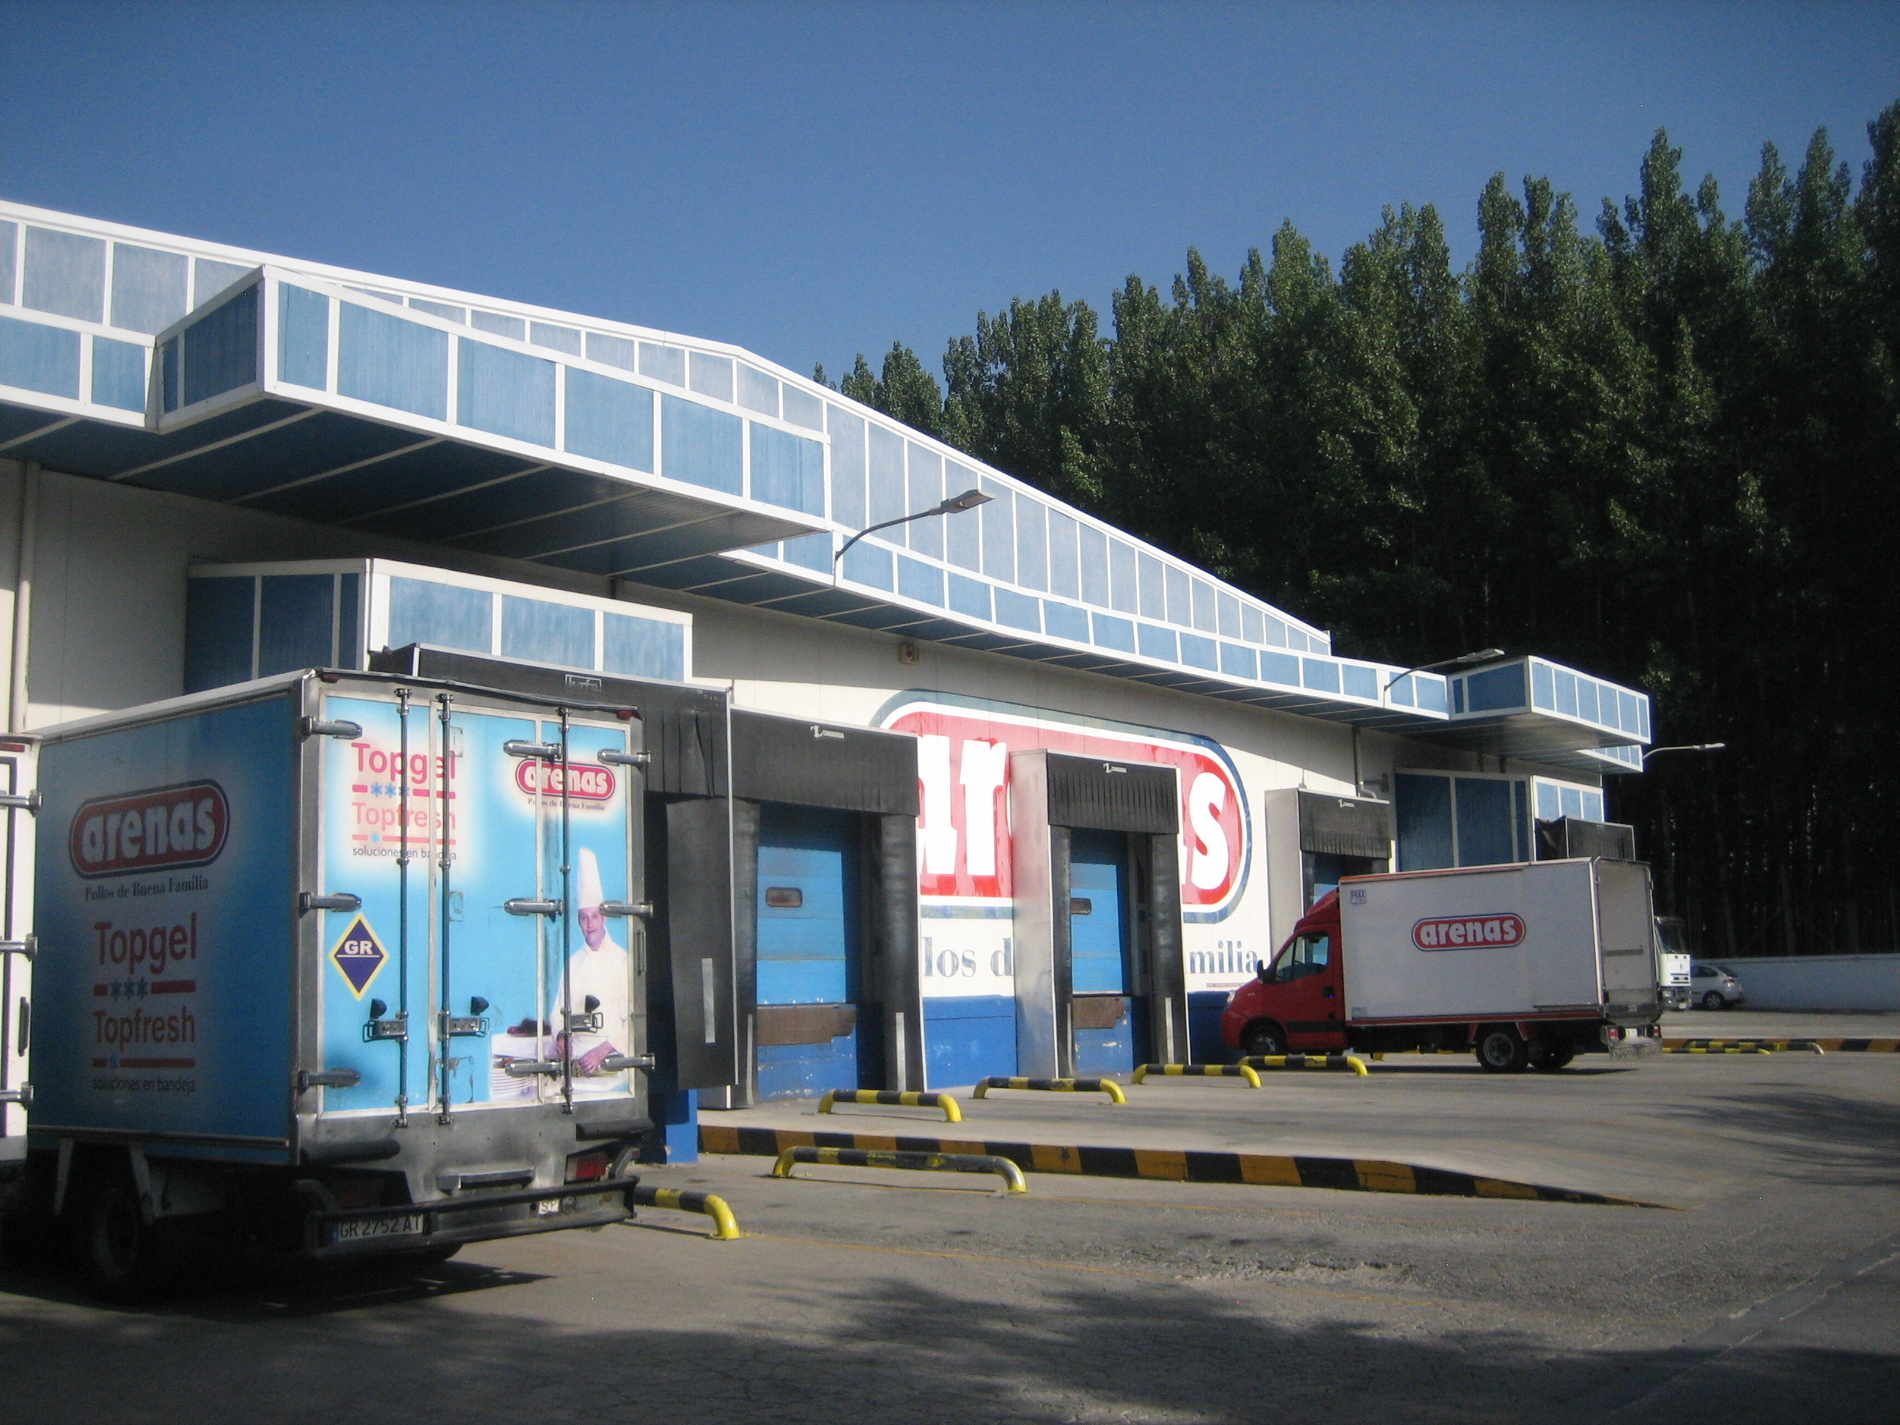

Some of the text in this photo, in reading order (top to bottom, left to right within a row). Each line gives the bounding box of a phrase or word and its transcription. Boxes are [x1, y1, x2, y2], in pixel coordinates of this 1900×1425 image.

[352, 742, 456, 784] Topgel
[524, 765, 608, 794] arenas
[82, 798, 216, 863] arenas
[352, 802, 456, 831] Topresh
[95, 912, 197, 974] Topgel
[1420, 919, 1517, 946] arenas
[344, 940, 374, 955] GR
[93, 1006, 195, 1051] Topfresh
[340, 1220, 358, 1241] GR
[362, 1214, 398, 1236] 2752
